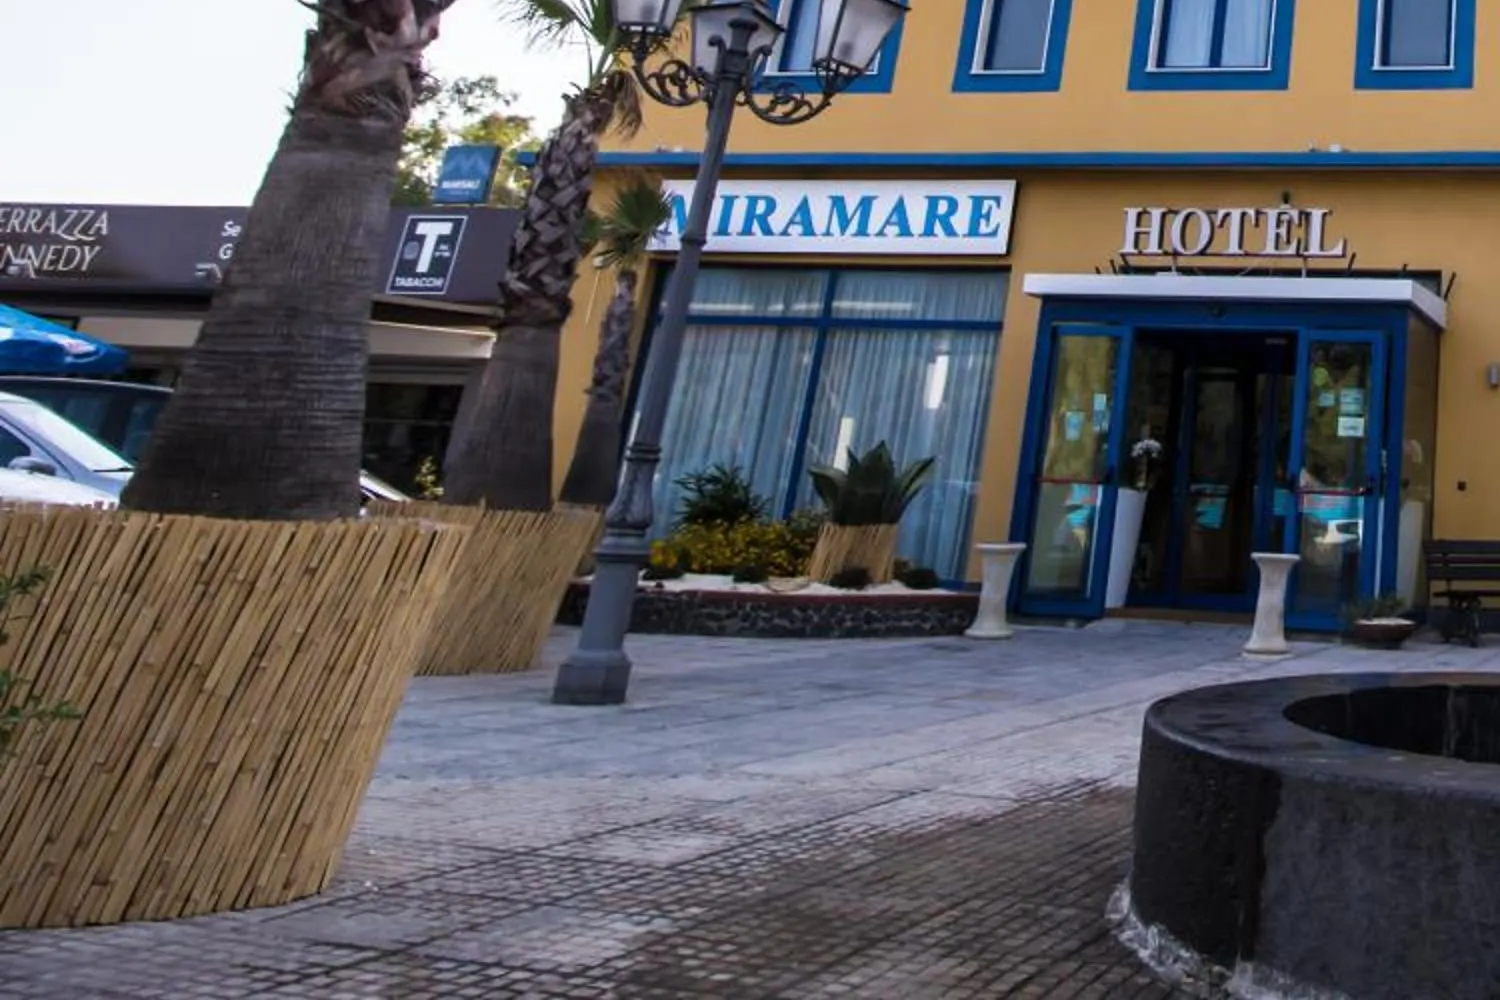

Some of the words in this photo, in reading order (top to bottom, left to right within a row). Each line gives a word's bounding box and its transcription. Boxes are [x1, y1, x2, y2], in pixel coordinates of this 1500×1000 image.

[0, 244, 102, 272] NNEDY
[415, 221, 454, 273] T
[1120, 207, 1347, 258] HOTEL
